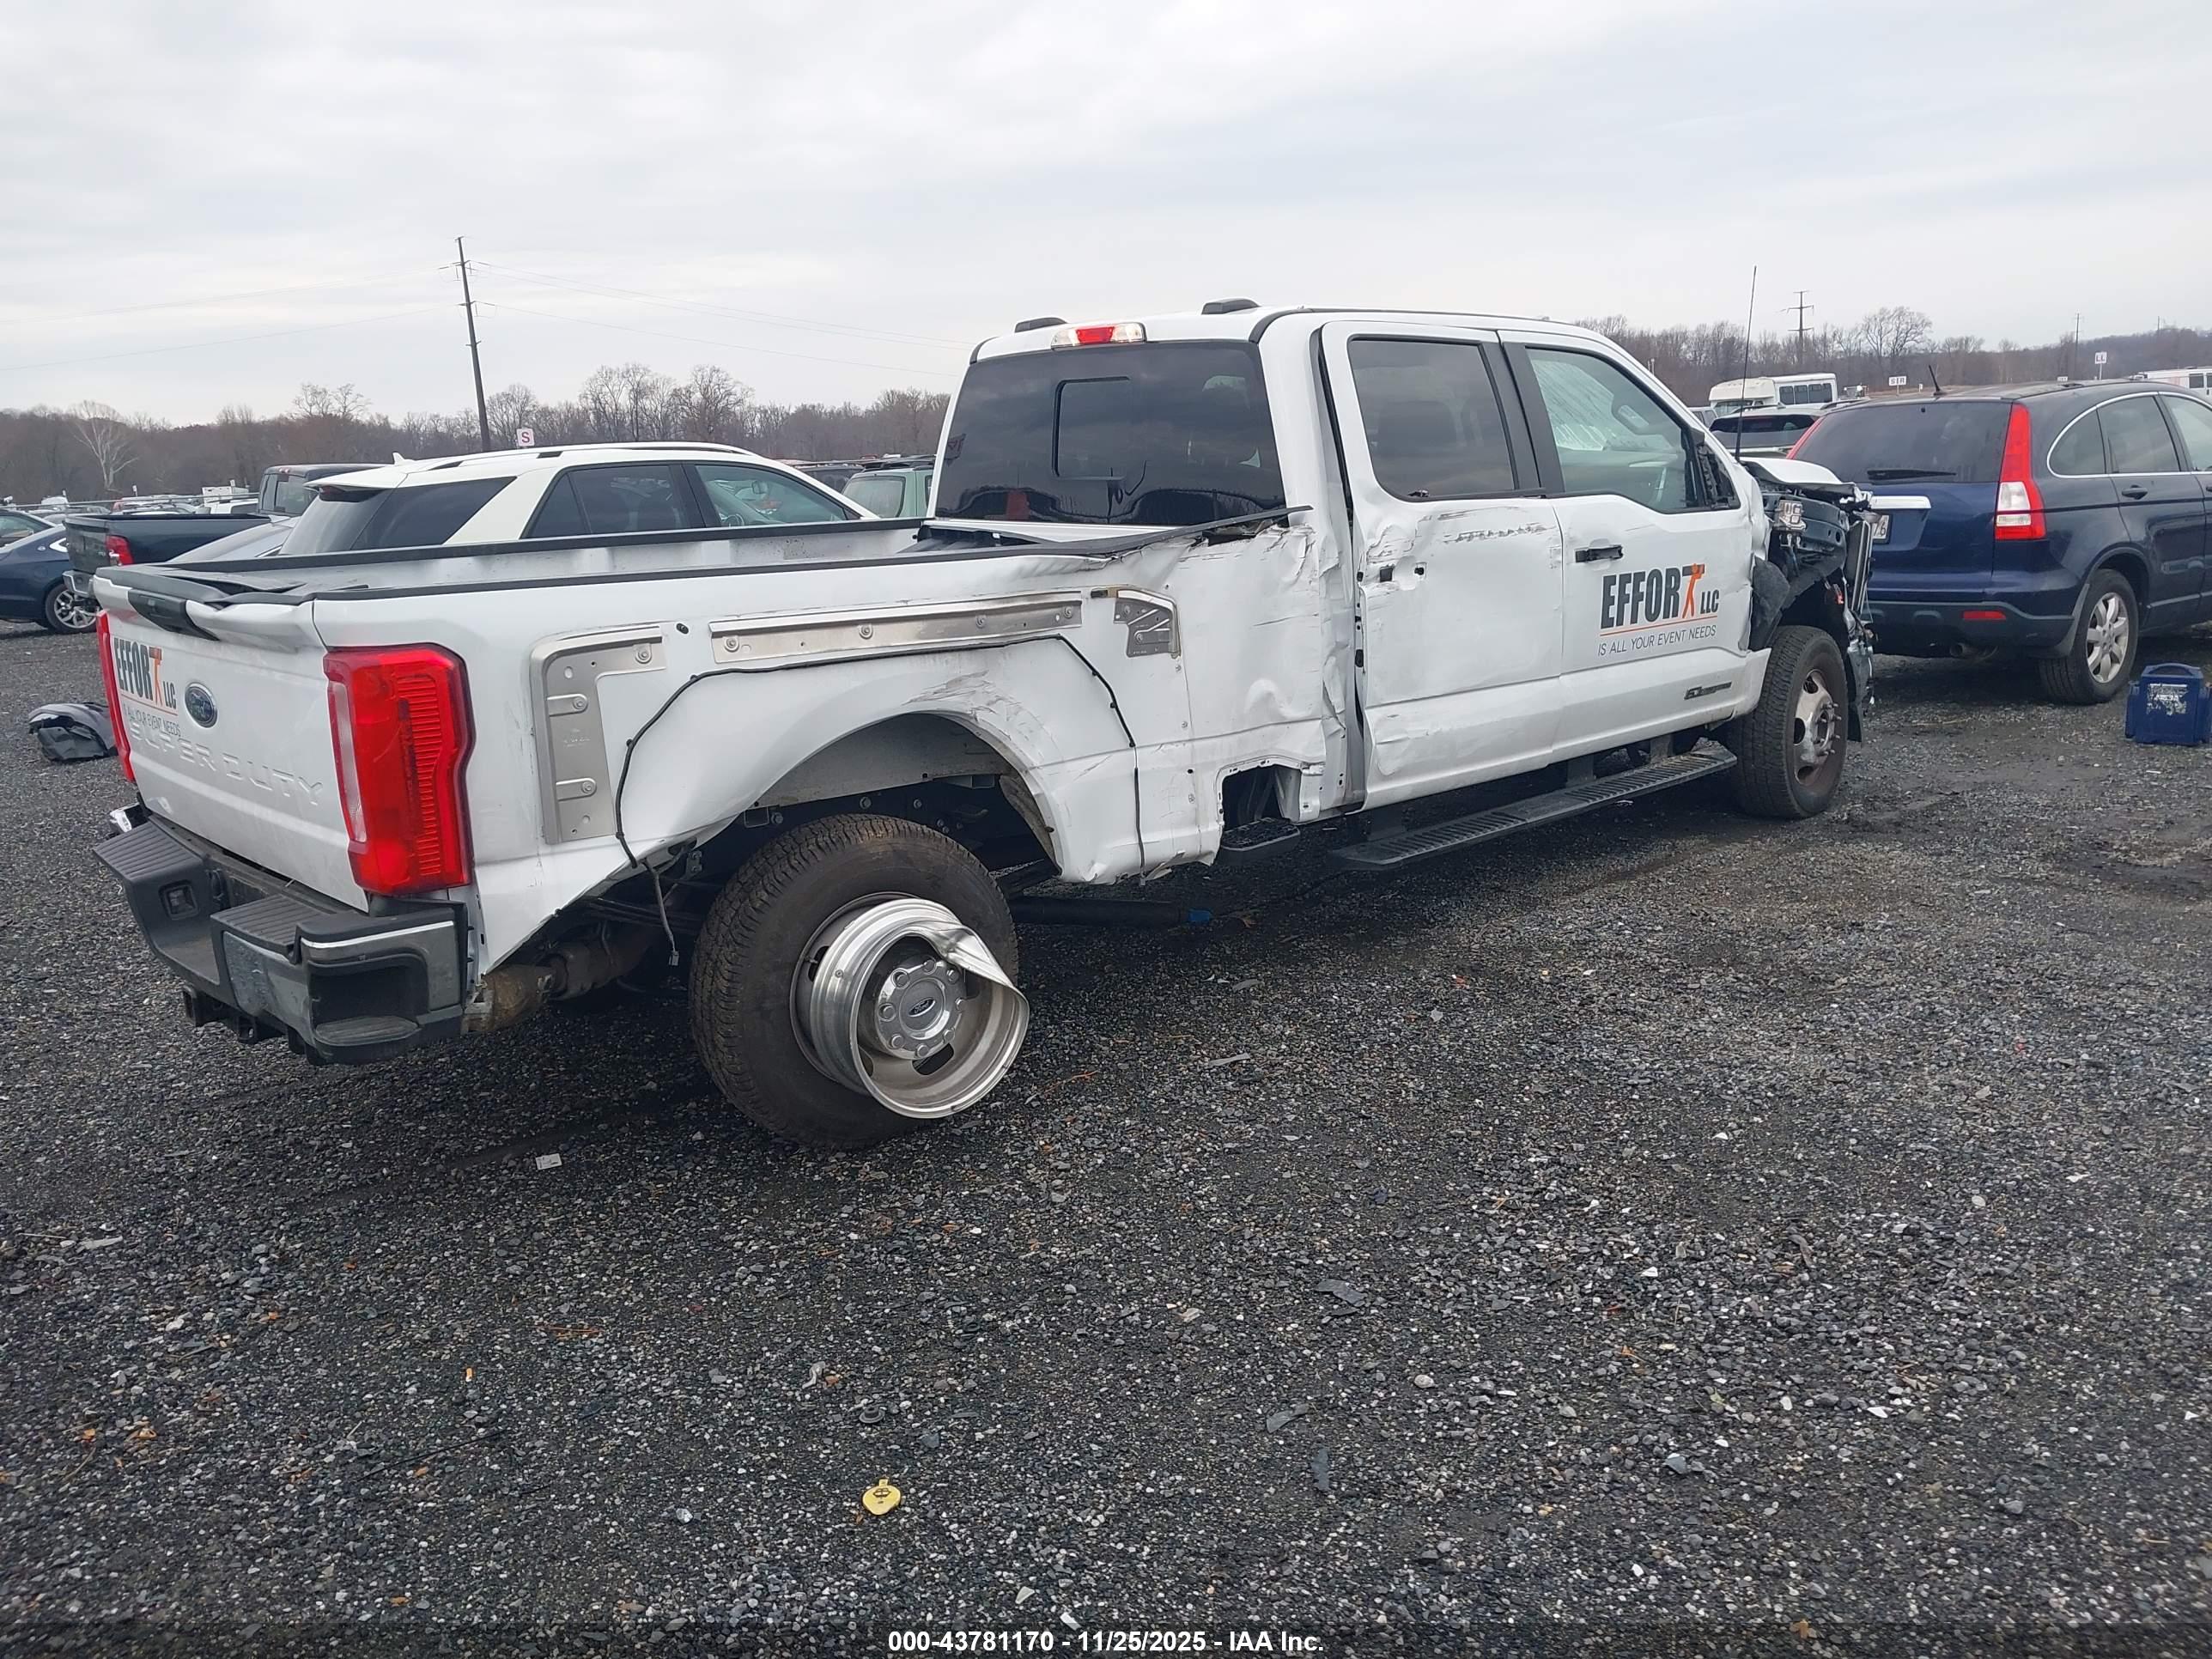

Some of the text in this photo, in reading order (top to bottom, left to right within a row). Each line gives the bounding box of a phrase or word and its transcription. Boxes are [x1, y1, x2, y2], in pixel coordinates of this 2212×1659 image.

[521, 431, 530, 443] S
[1601, 563, 1720, 629] EFFORT LLC
[1598, 624, 1717, 656] IS ALL YOUR EVENT NEEDS
[113, 637, 177, 710] EFFORT LLC
[130, 721, 324, 806] SUPER DUTY
